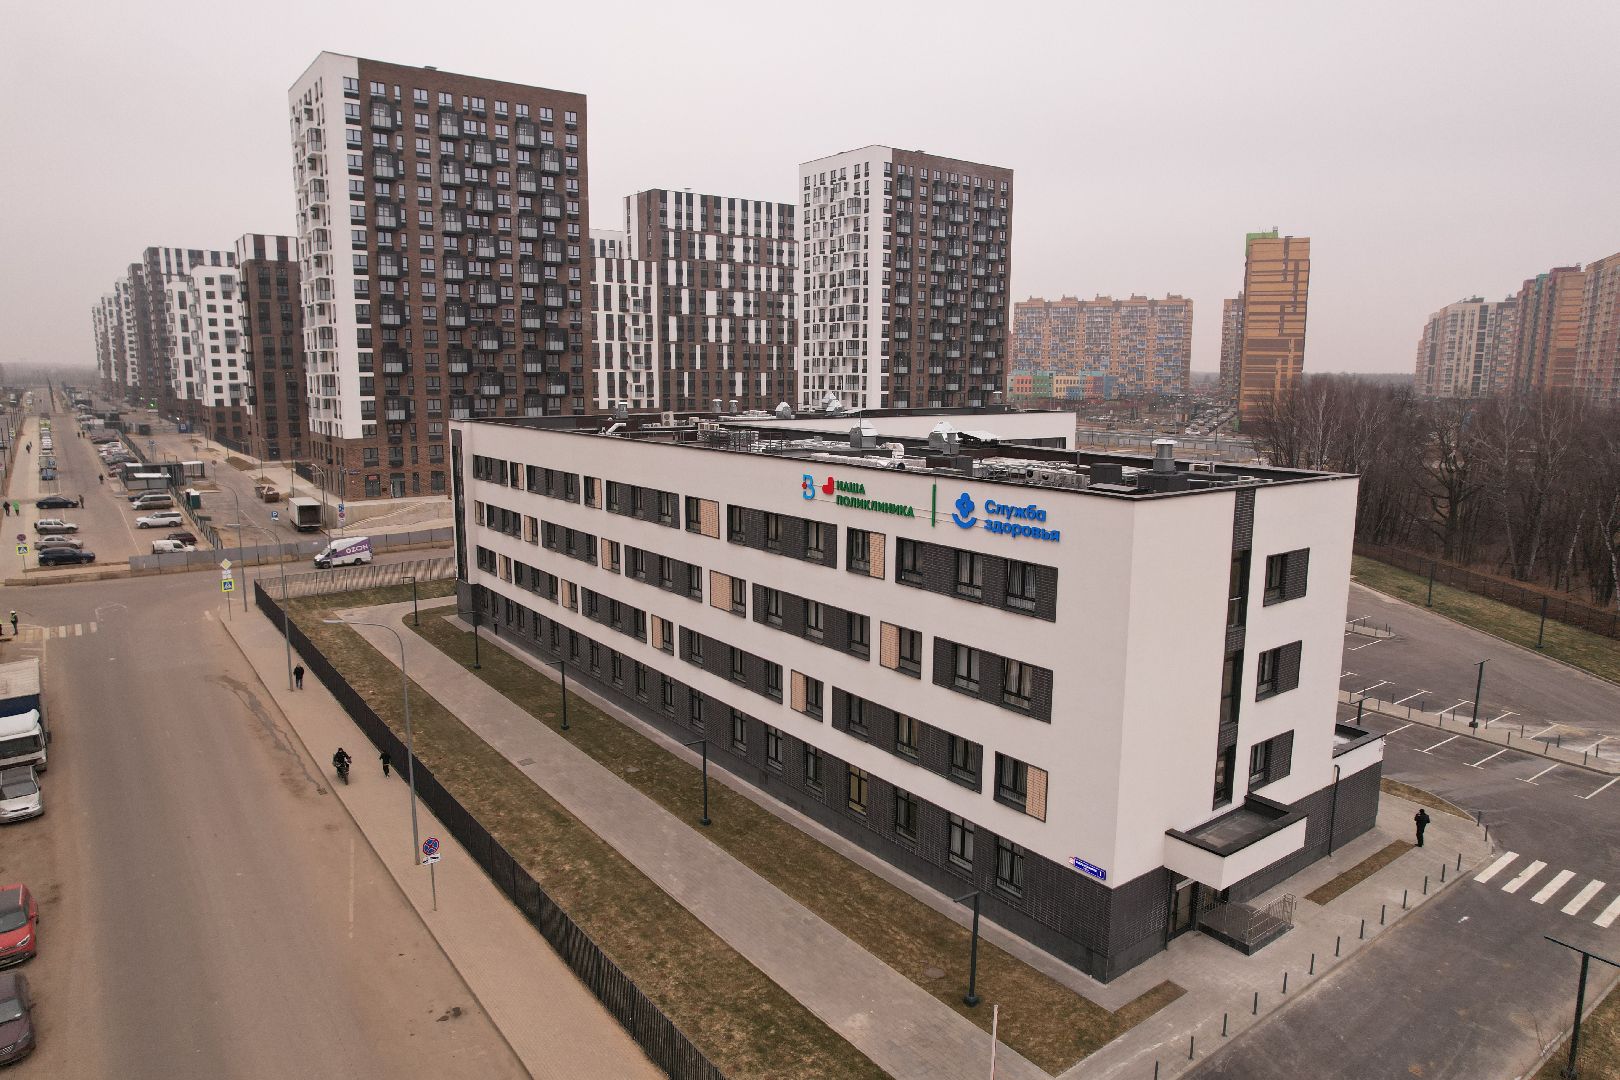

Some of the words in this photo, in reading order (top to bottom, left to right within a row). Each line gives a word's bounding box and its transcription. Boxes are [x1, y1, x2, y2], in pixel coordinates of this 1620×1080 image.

[836, 480, 866, 494] НАША
[836, 495, 915, 517] ПОЛИКЛИНИКА
[984, 500, 1047, 522] Служба
[984, 519, 1061, 542] здоровья
[345, 543, 369, 554] OZON
